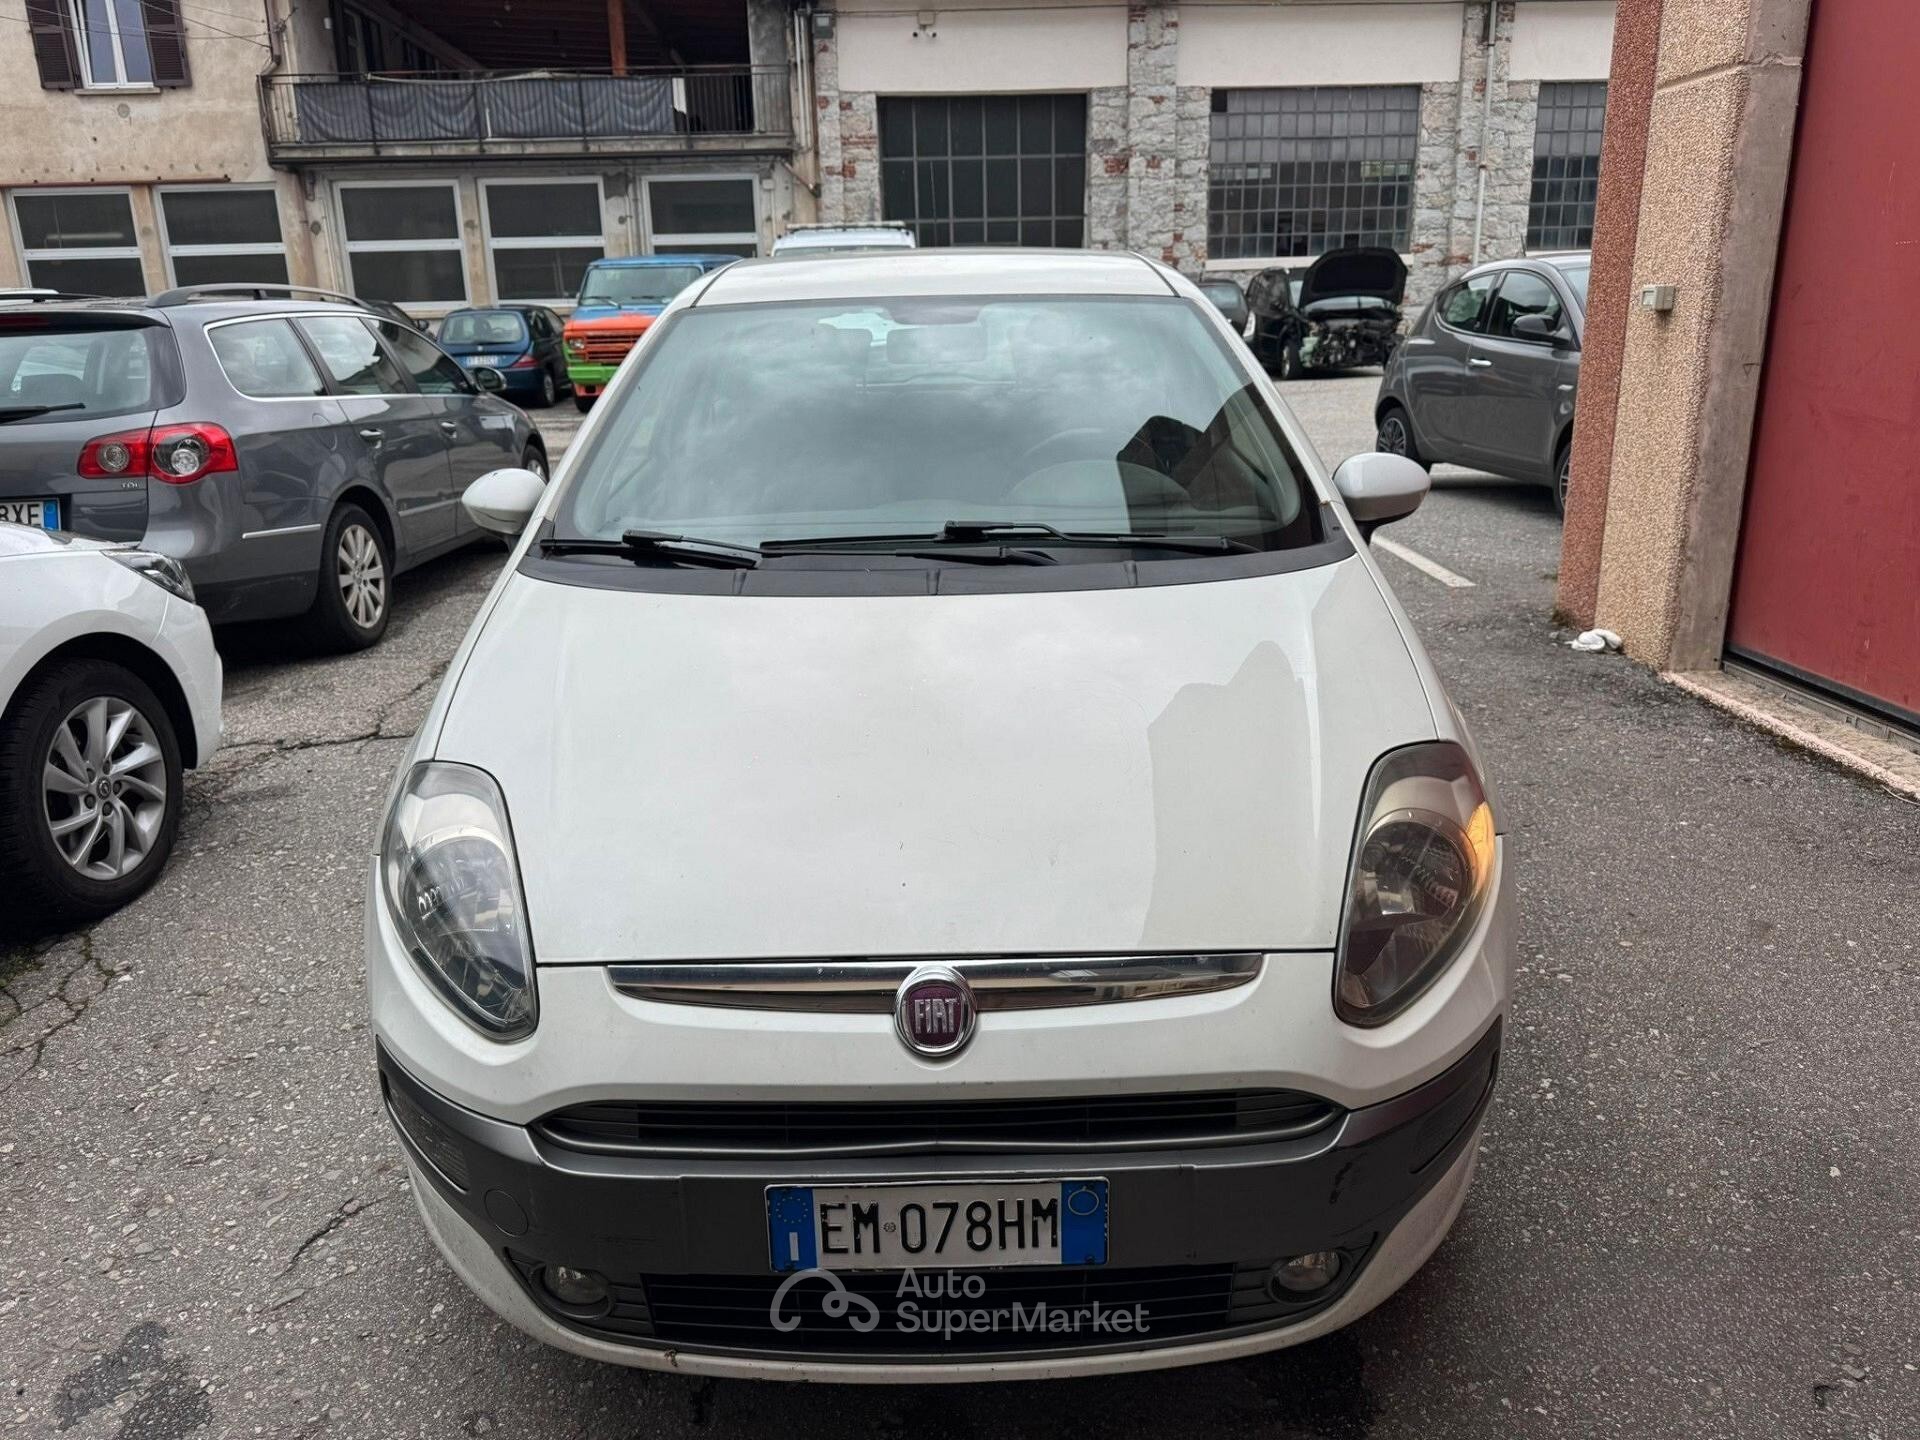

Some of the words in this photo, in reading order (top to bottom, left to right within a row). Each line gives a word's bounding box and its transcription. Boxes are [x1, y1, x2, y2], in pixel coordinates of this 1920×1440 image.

[914, 997, 957, 1034] FIAT
[821, 1201, 880, 1254] EM
[899, 1198, 1059, 1254] 078HM
